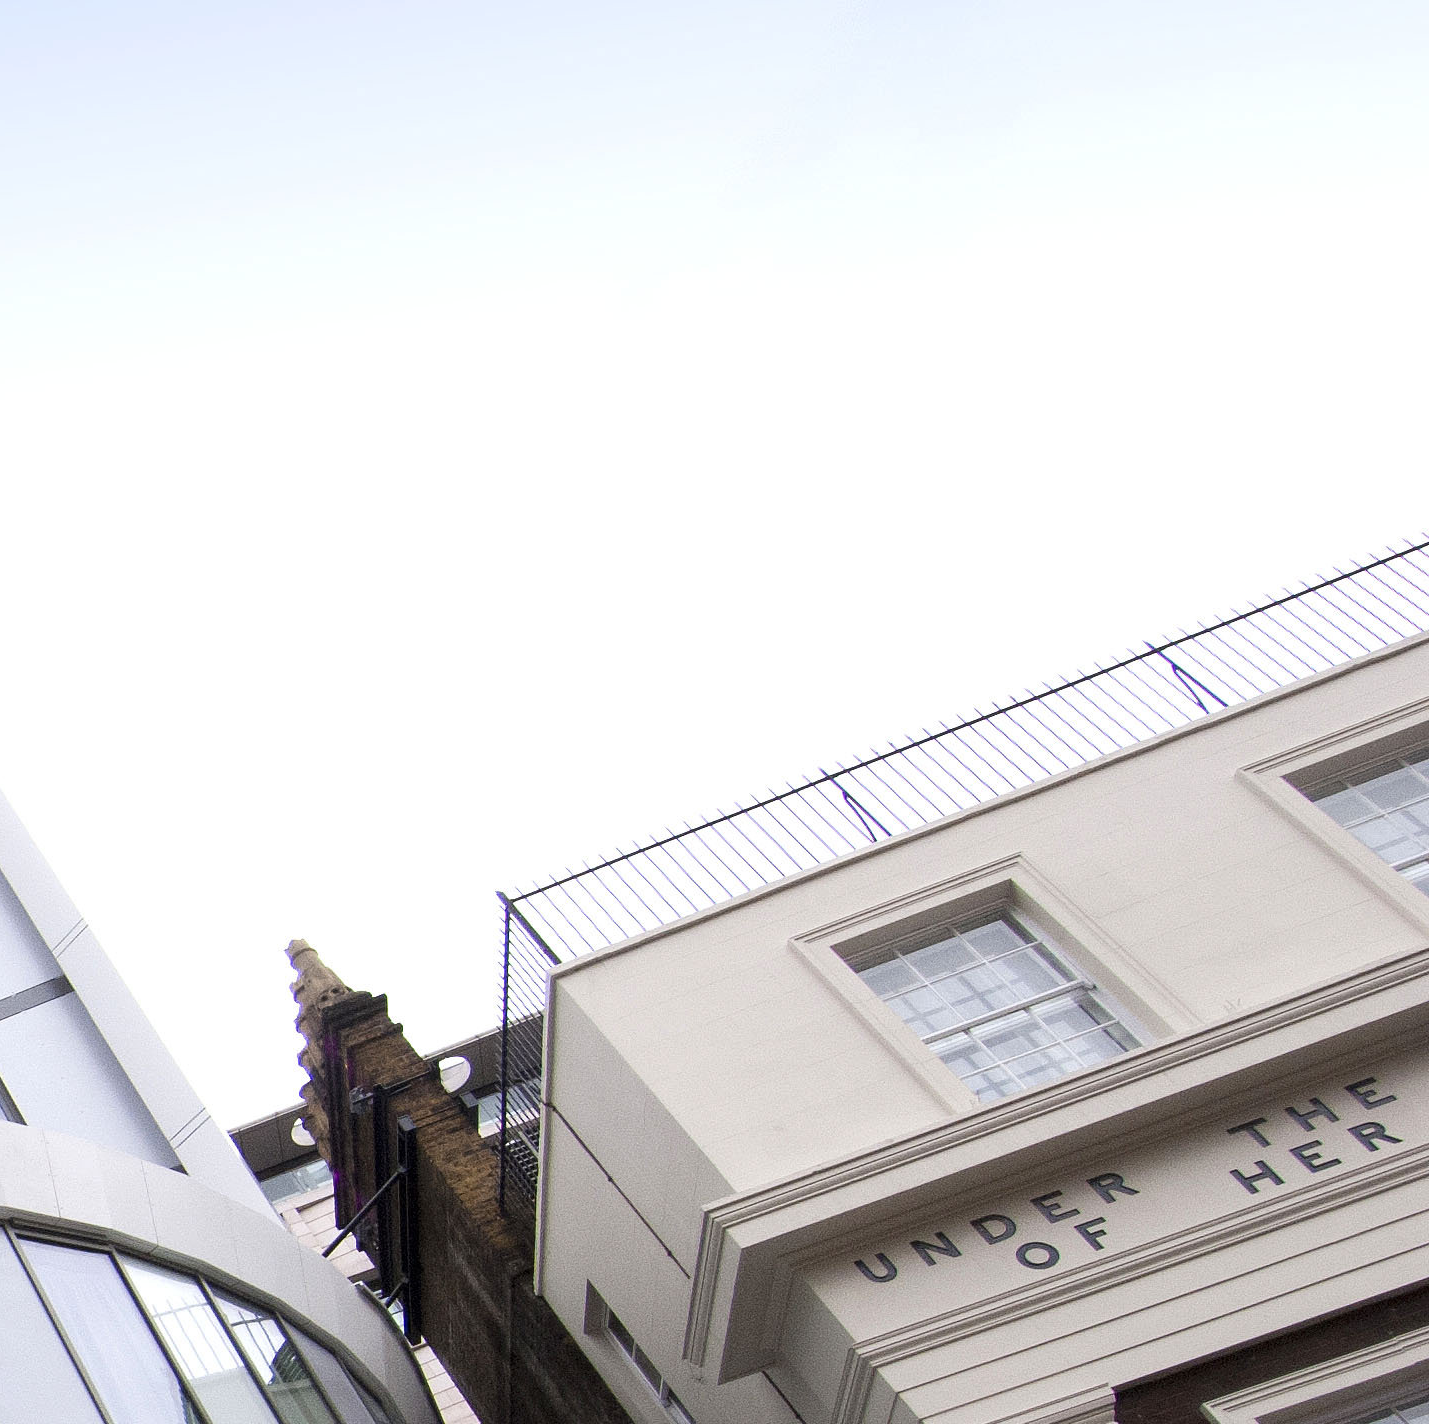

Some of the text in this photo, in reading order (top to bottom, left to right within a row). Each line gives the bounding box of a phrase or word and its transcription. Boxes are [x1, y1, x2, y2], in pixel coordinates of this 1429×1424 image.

[854, 1076, 1397, 1283] UNDER THE
[1015, 1121, 1403, 1270] OF HER
